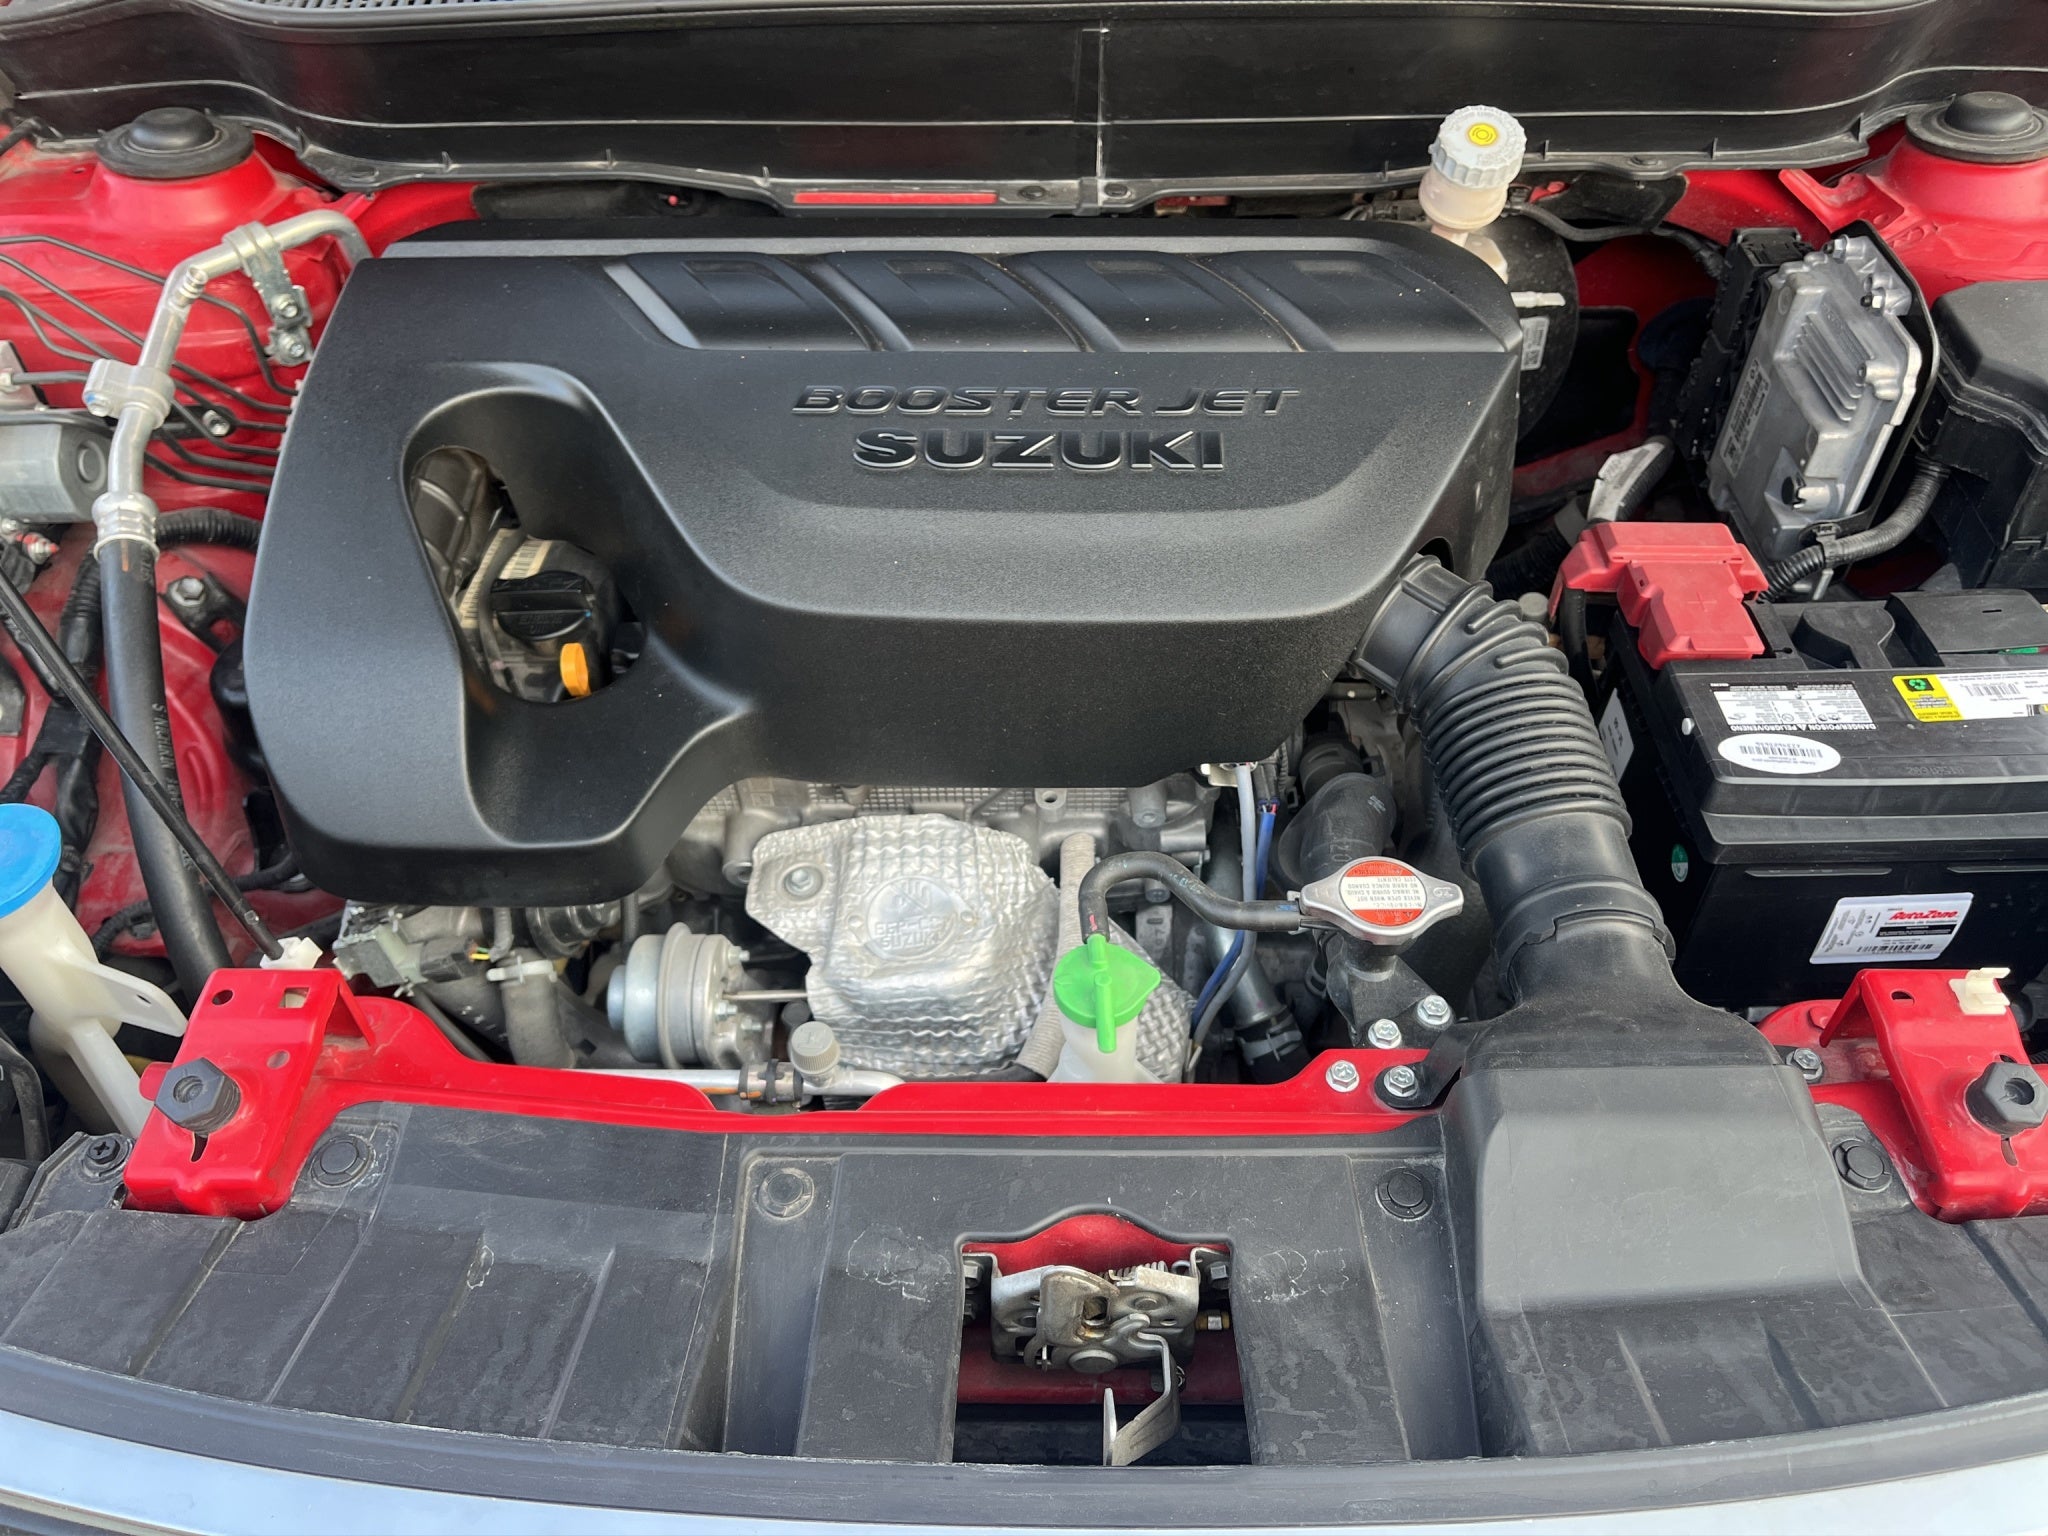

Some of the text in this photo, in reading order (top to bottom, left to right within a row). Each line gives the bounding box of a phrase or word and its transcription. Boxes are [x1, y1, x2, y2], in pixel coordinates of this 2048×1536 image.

[791, 384, 1300, 416] BOOSTER JET
[852, 426, 1225, 471] SUZUKI
[1891, 909, 1958, 920] AutoZone
